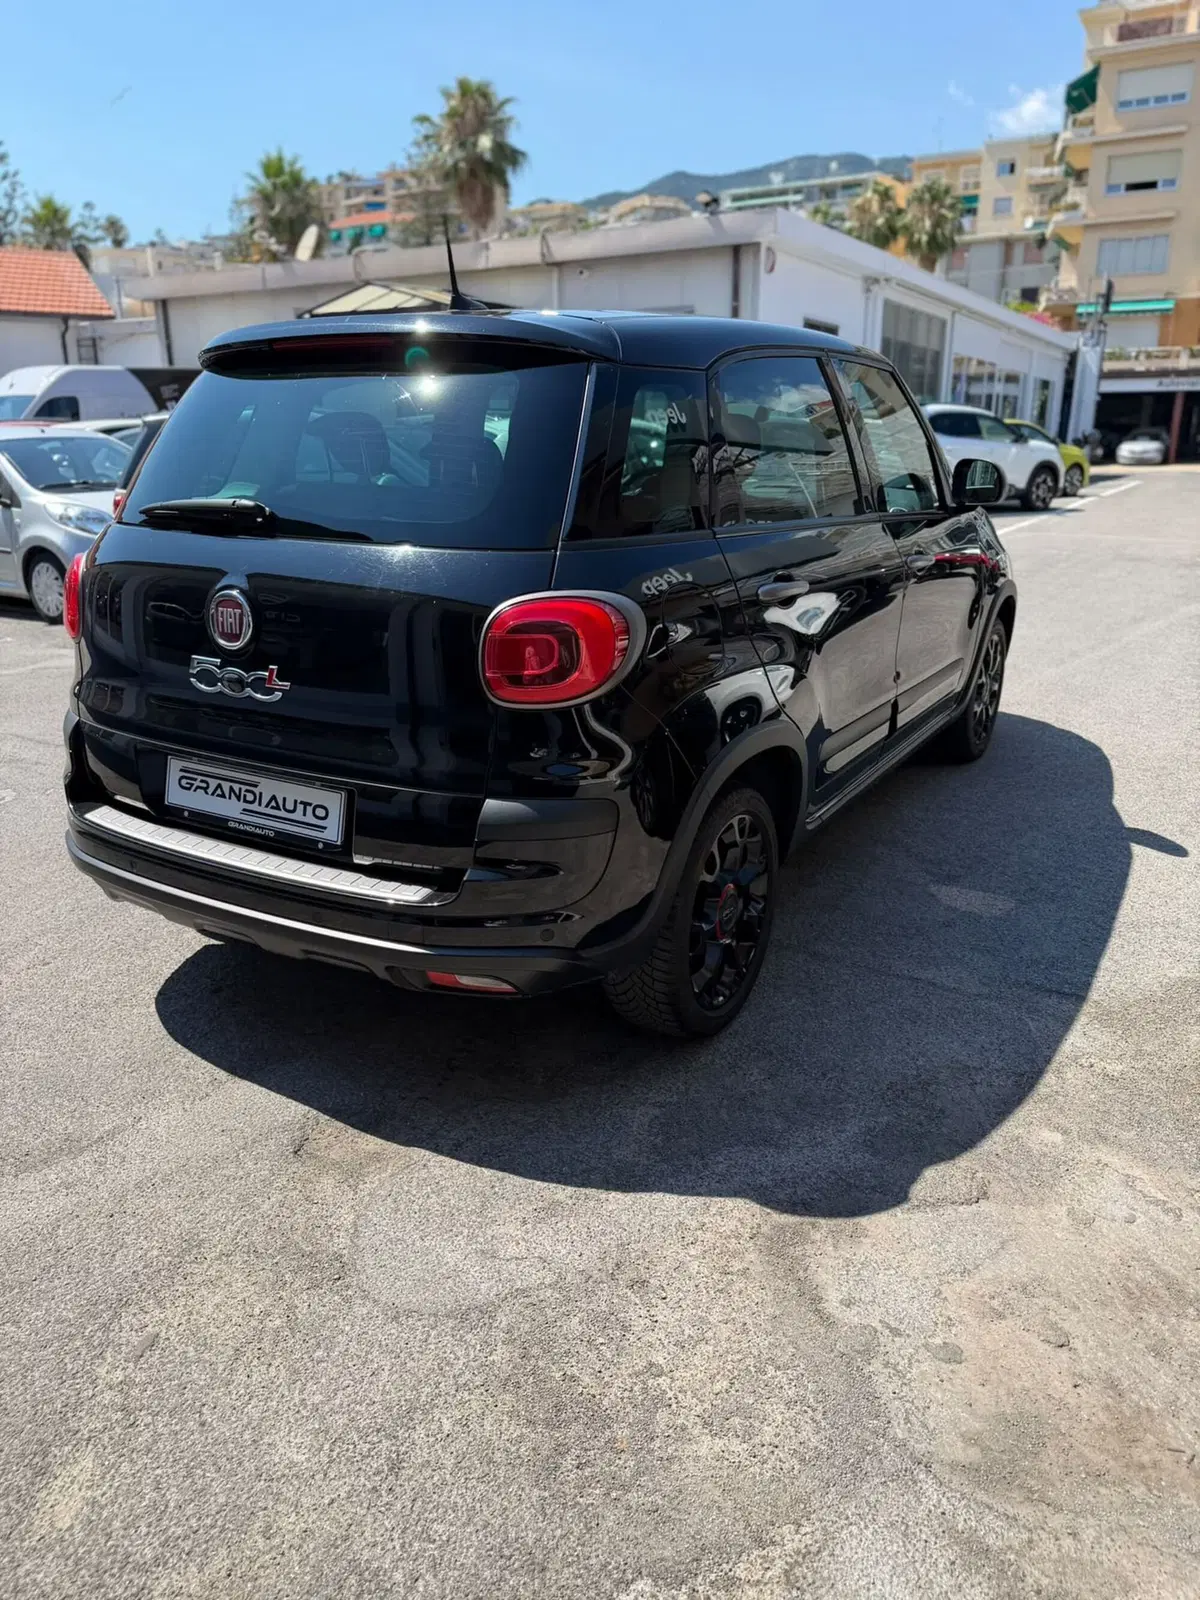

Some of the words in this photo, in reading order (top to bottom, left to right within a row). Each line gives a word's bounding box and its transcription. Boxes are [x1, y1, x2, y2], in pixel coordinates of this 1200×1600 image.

[218, 607, 242, 634] FIAT
[178, 775, 330, 821] GRANDIAUTO
[228, 821, 275, 837] GRANDIAUTO
